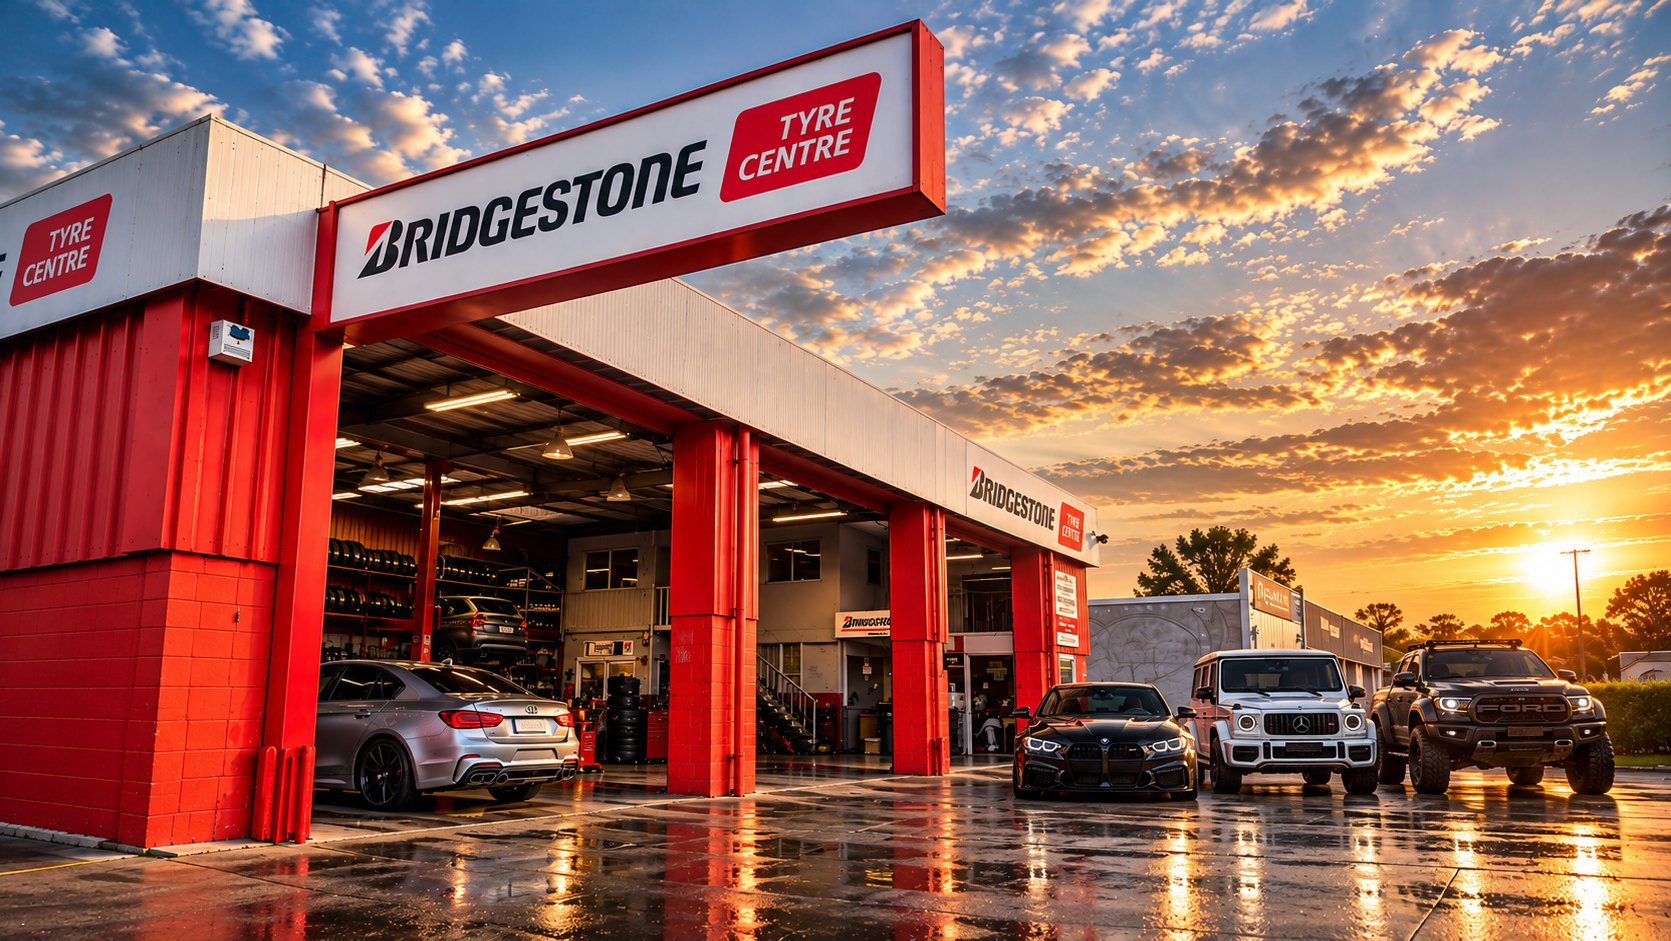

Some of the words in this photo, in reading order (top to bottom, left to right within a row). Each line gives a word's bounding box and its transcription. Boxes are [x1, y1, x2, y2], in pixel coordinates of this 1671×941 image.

[780, 97, 855, 141] TYRE
[738, 129, 853, 182] CENTRE
[359, 140, 707, 278] BRIDGESTONE
[49, 217, 94, 252] TYRE
[23, 245, 90, 287] CENTRE
[969, 466, 1055, 531] BRIDGESTONE
[1477, 704, 1565, 713] FORD
